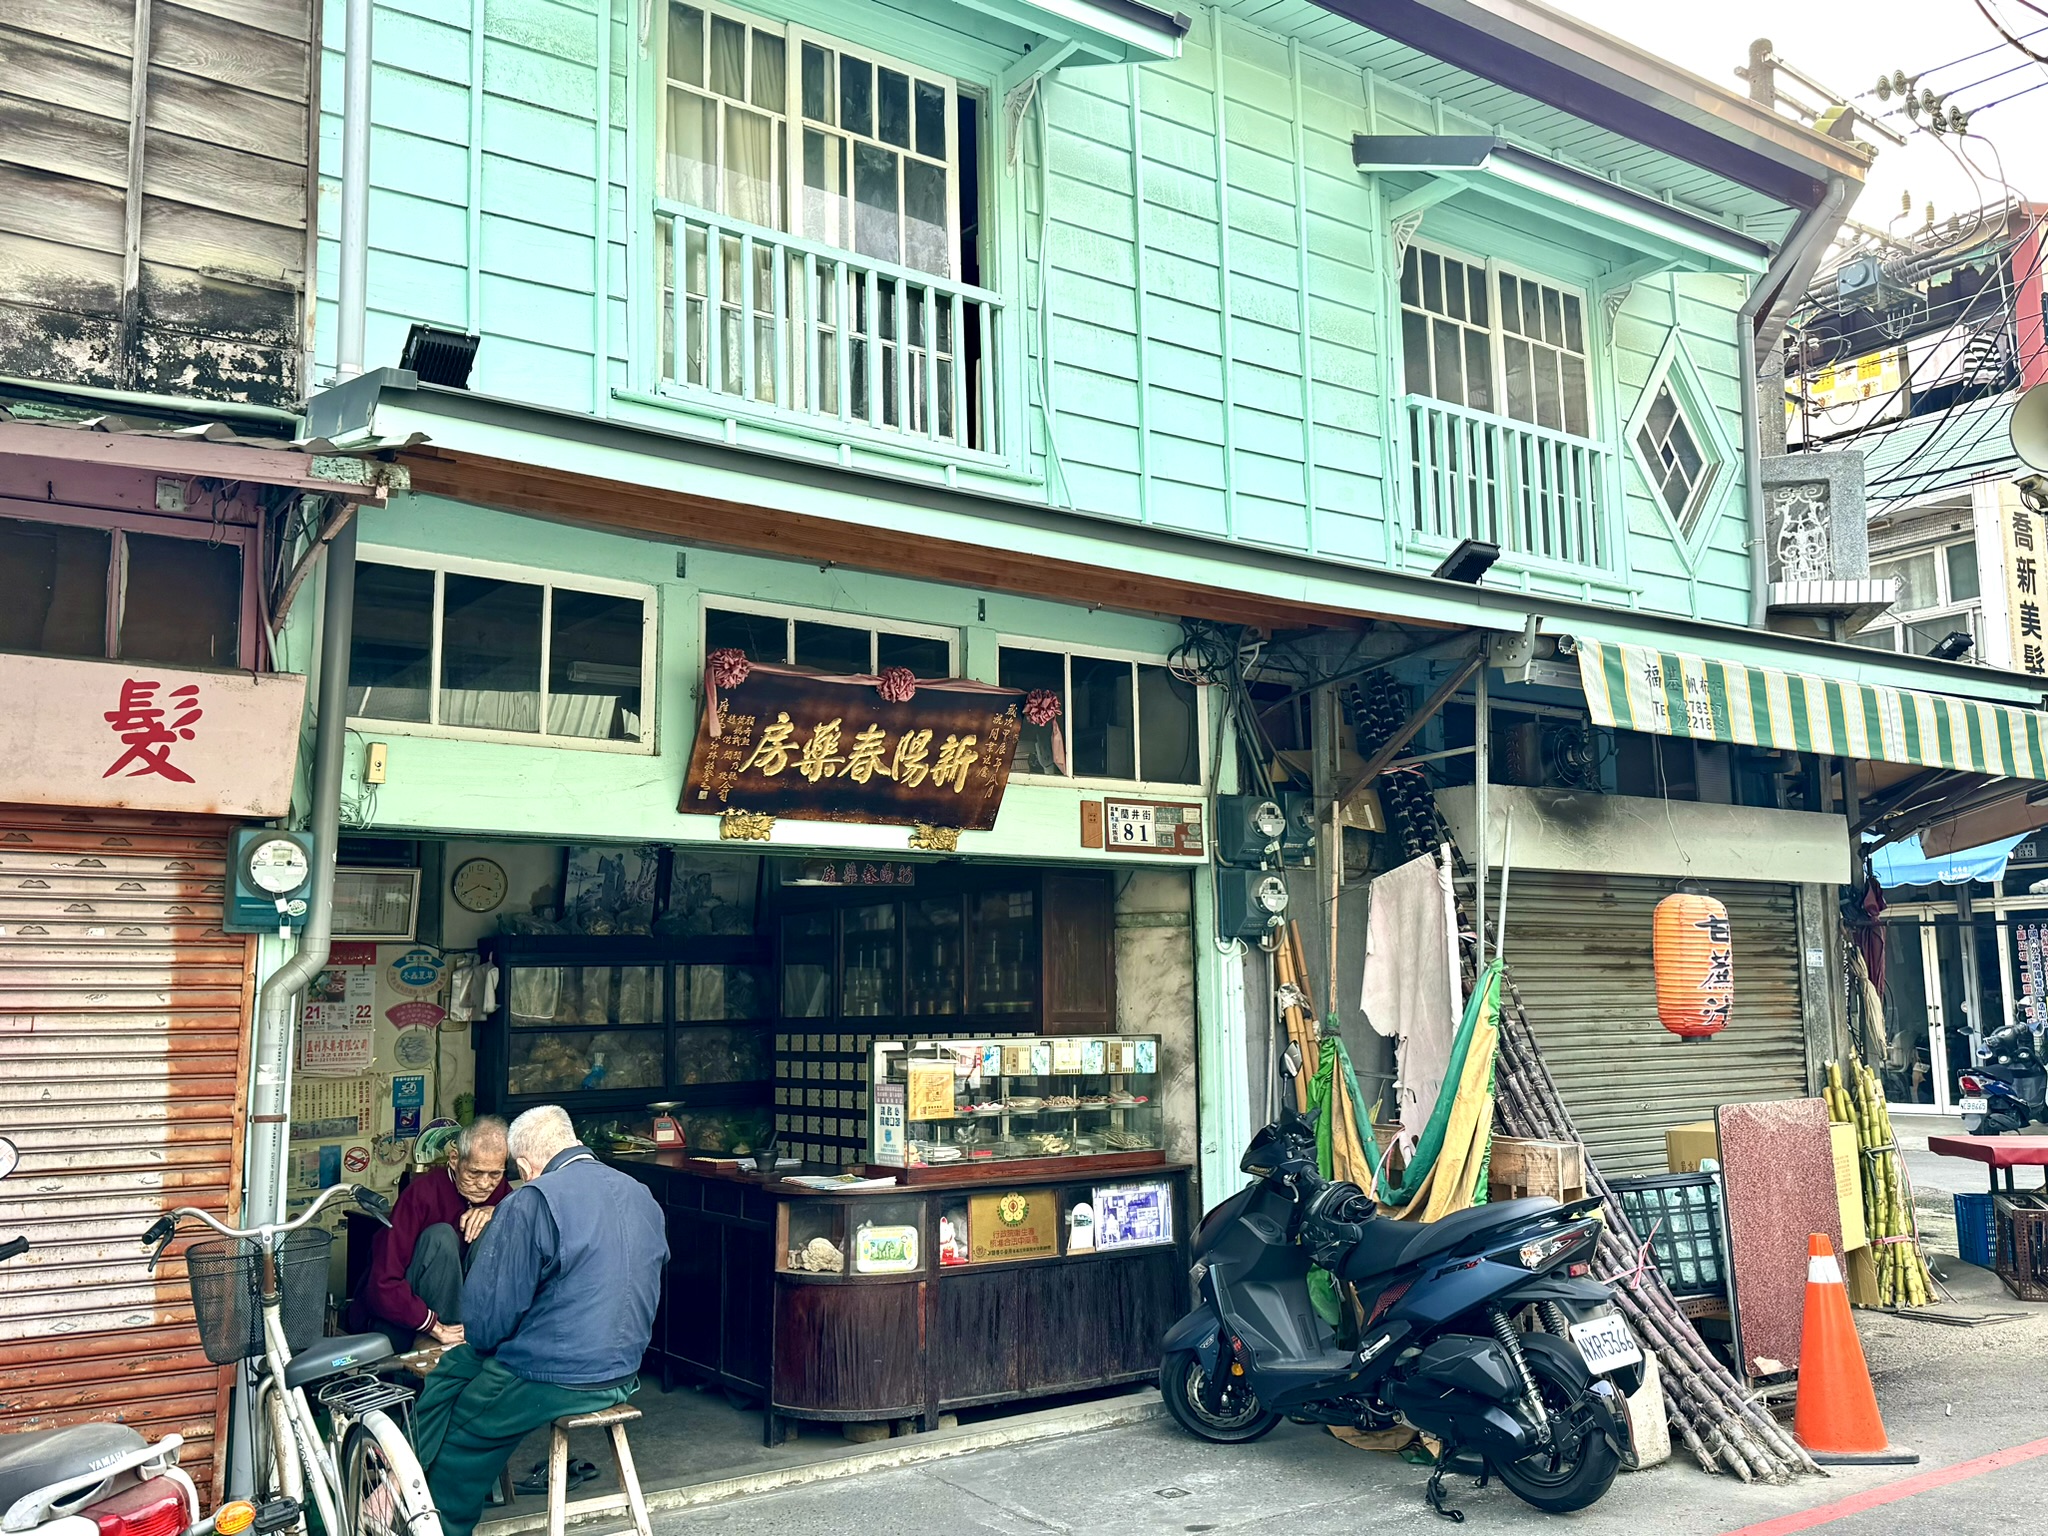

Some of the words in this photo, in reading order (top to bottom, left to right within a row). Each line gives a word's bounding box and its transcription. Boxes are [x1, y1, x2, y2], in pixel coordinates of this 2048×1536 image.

[102, 678, 203, 783] 髮
[738, 711, 979, 793] 新陽春藥房
[1120, 808, 1151, 821] 蘭井街
[1124, 823, 1148, 842] 81
[2020, 849, 2034, 857] 33
[305, 1006, 320, 1020] 21
[356, 1005, 371, 1018] 22
[88, 1450, 128, 1472] YAMAHA
